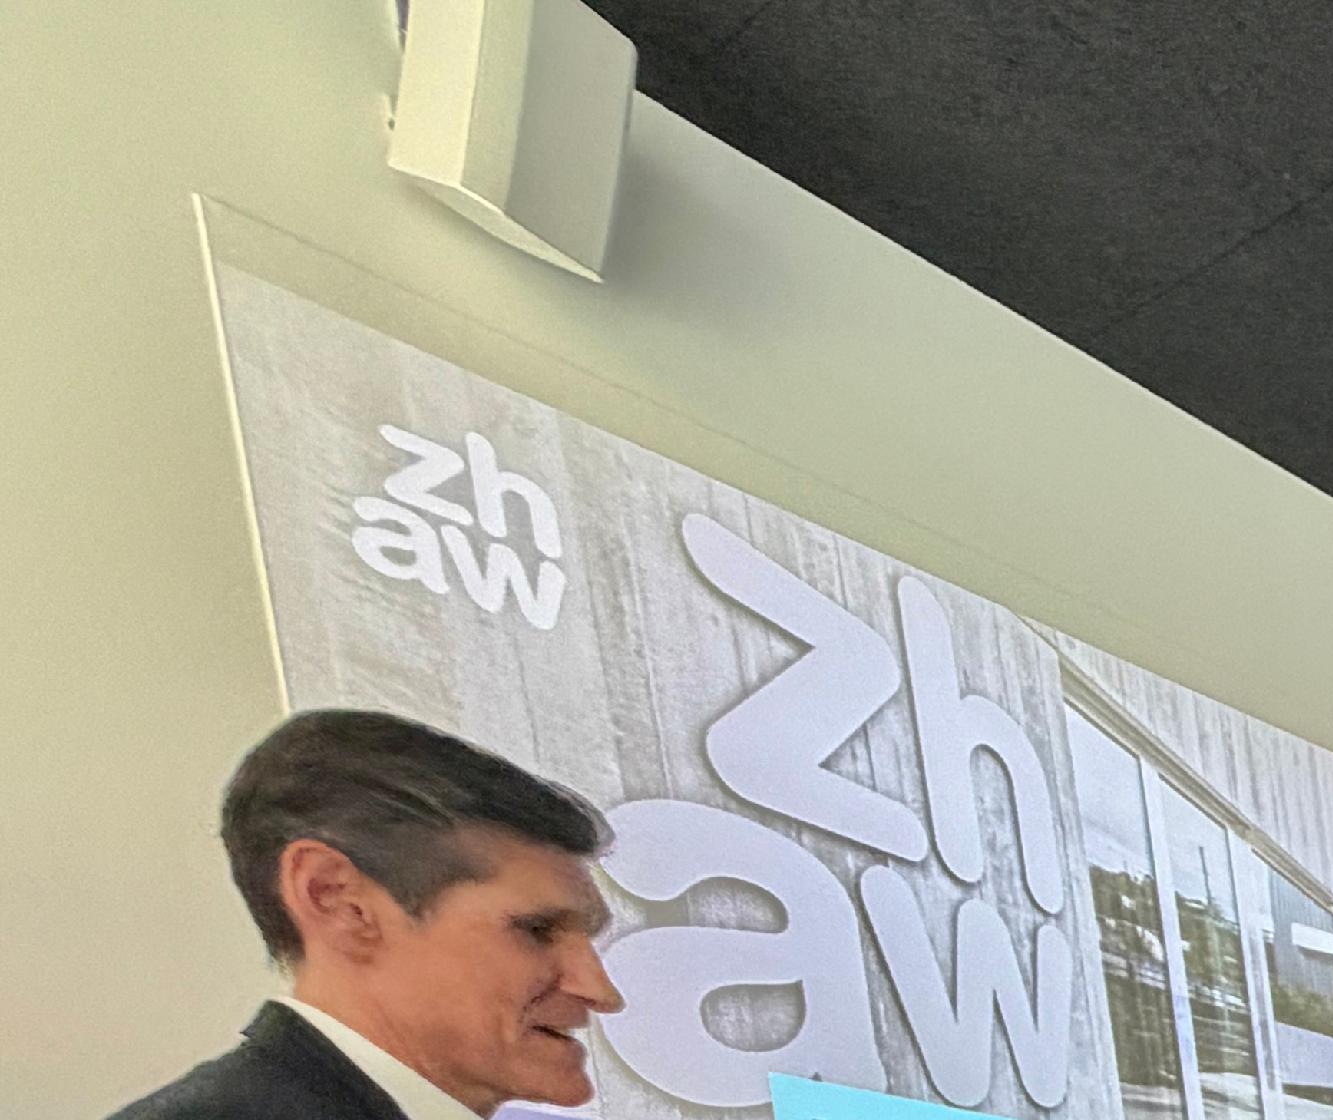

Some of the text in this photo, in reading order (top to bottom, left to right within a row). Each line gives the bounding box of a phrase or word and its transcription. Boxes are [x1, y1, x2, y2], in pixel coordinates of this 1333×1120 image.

[351, 495, 568, 630] aw
[379, 424, 563, 556] zh
[681, 513, 1064, 916] zh
[597, 799, 1073, 1109] aw
